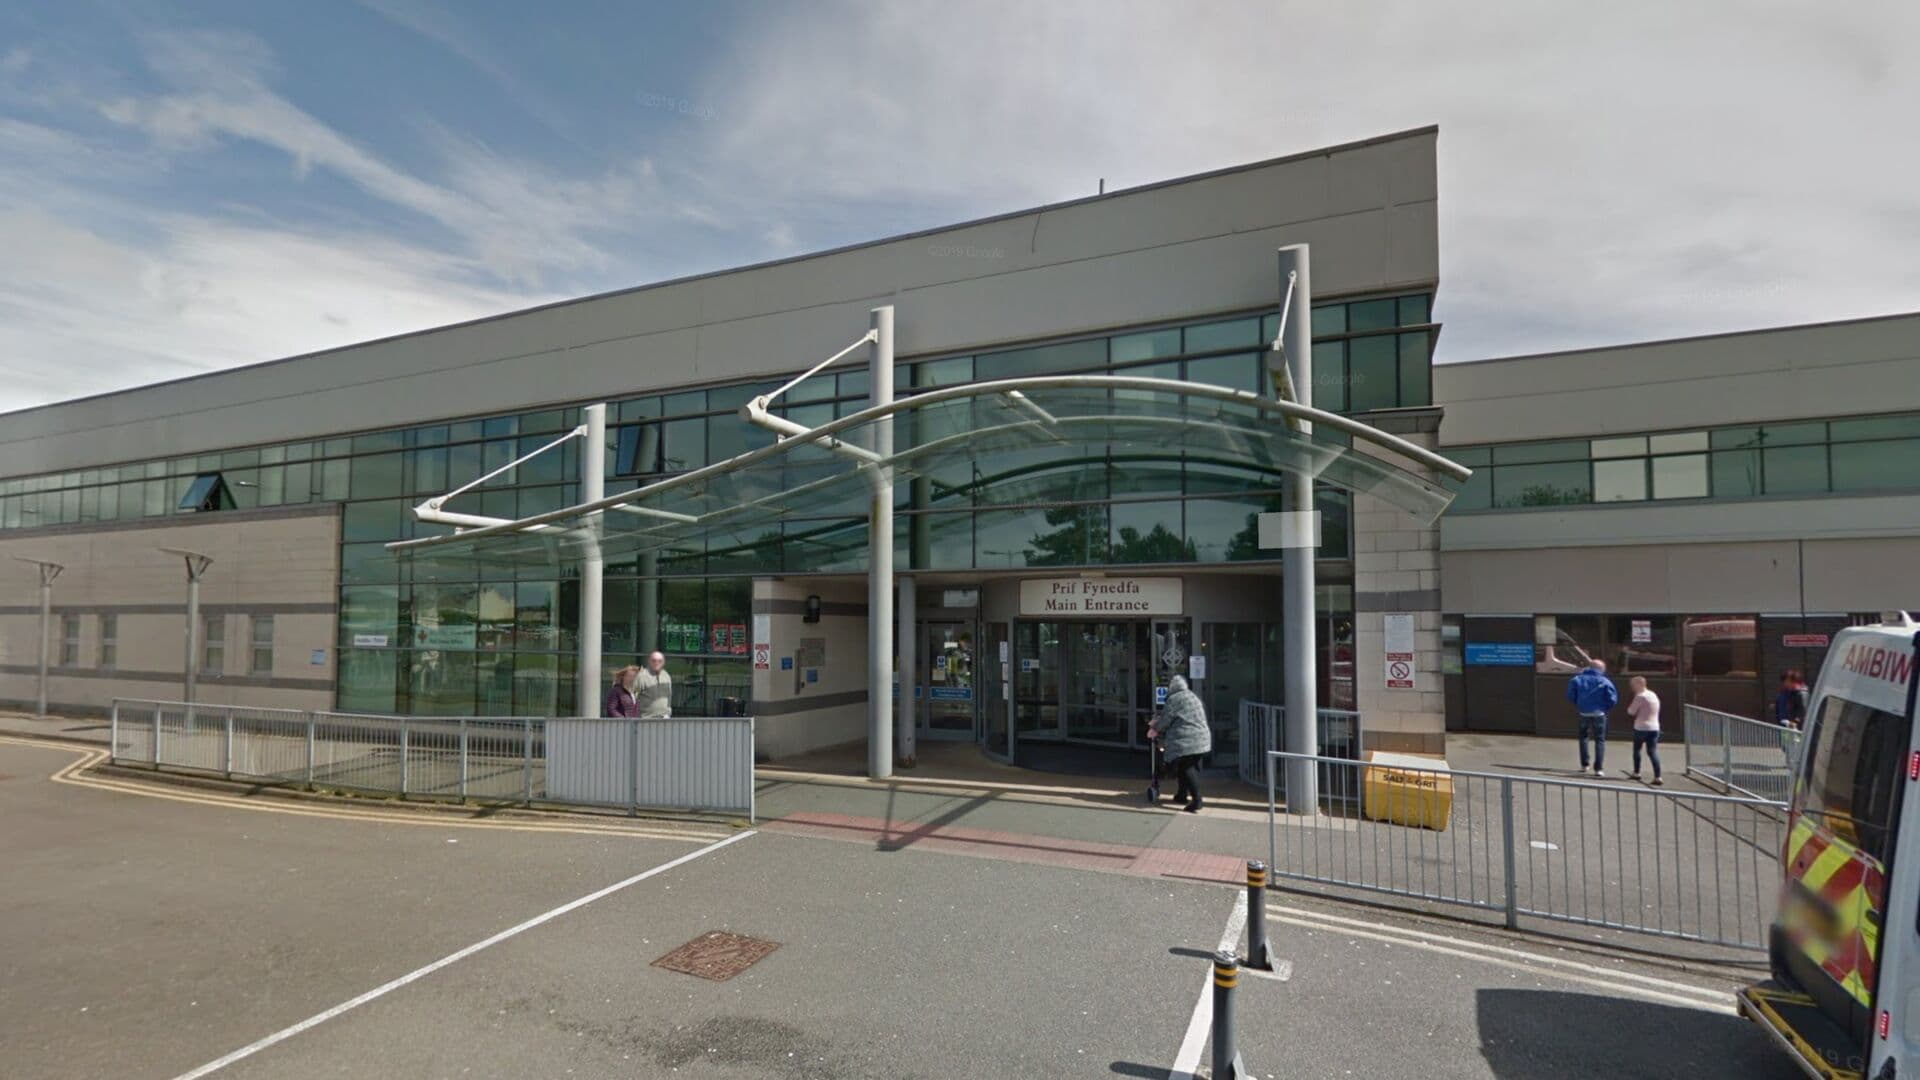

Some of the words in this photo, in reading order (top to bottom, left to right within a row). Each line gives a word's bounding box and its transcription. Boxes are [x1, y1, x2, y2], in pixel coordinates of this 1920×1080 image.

[1052, 582, 1076, 595] Prif
[1083, 581, 1139, 596] Fynedfa
[1045, 599, 1077, 611] Main
[1085, 599, 1149, 611] Entrance
[1383, 774, 1404, 784] SALT
